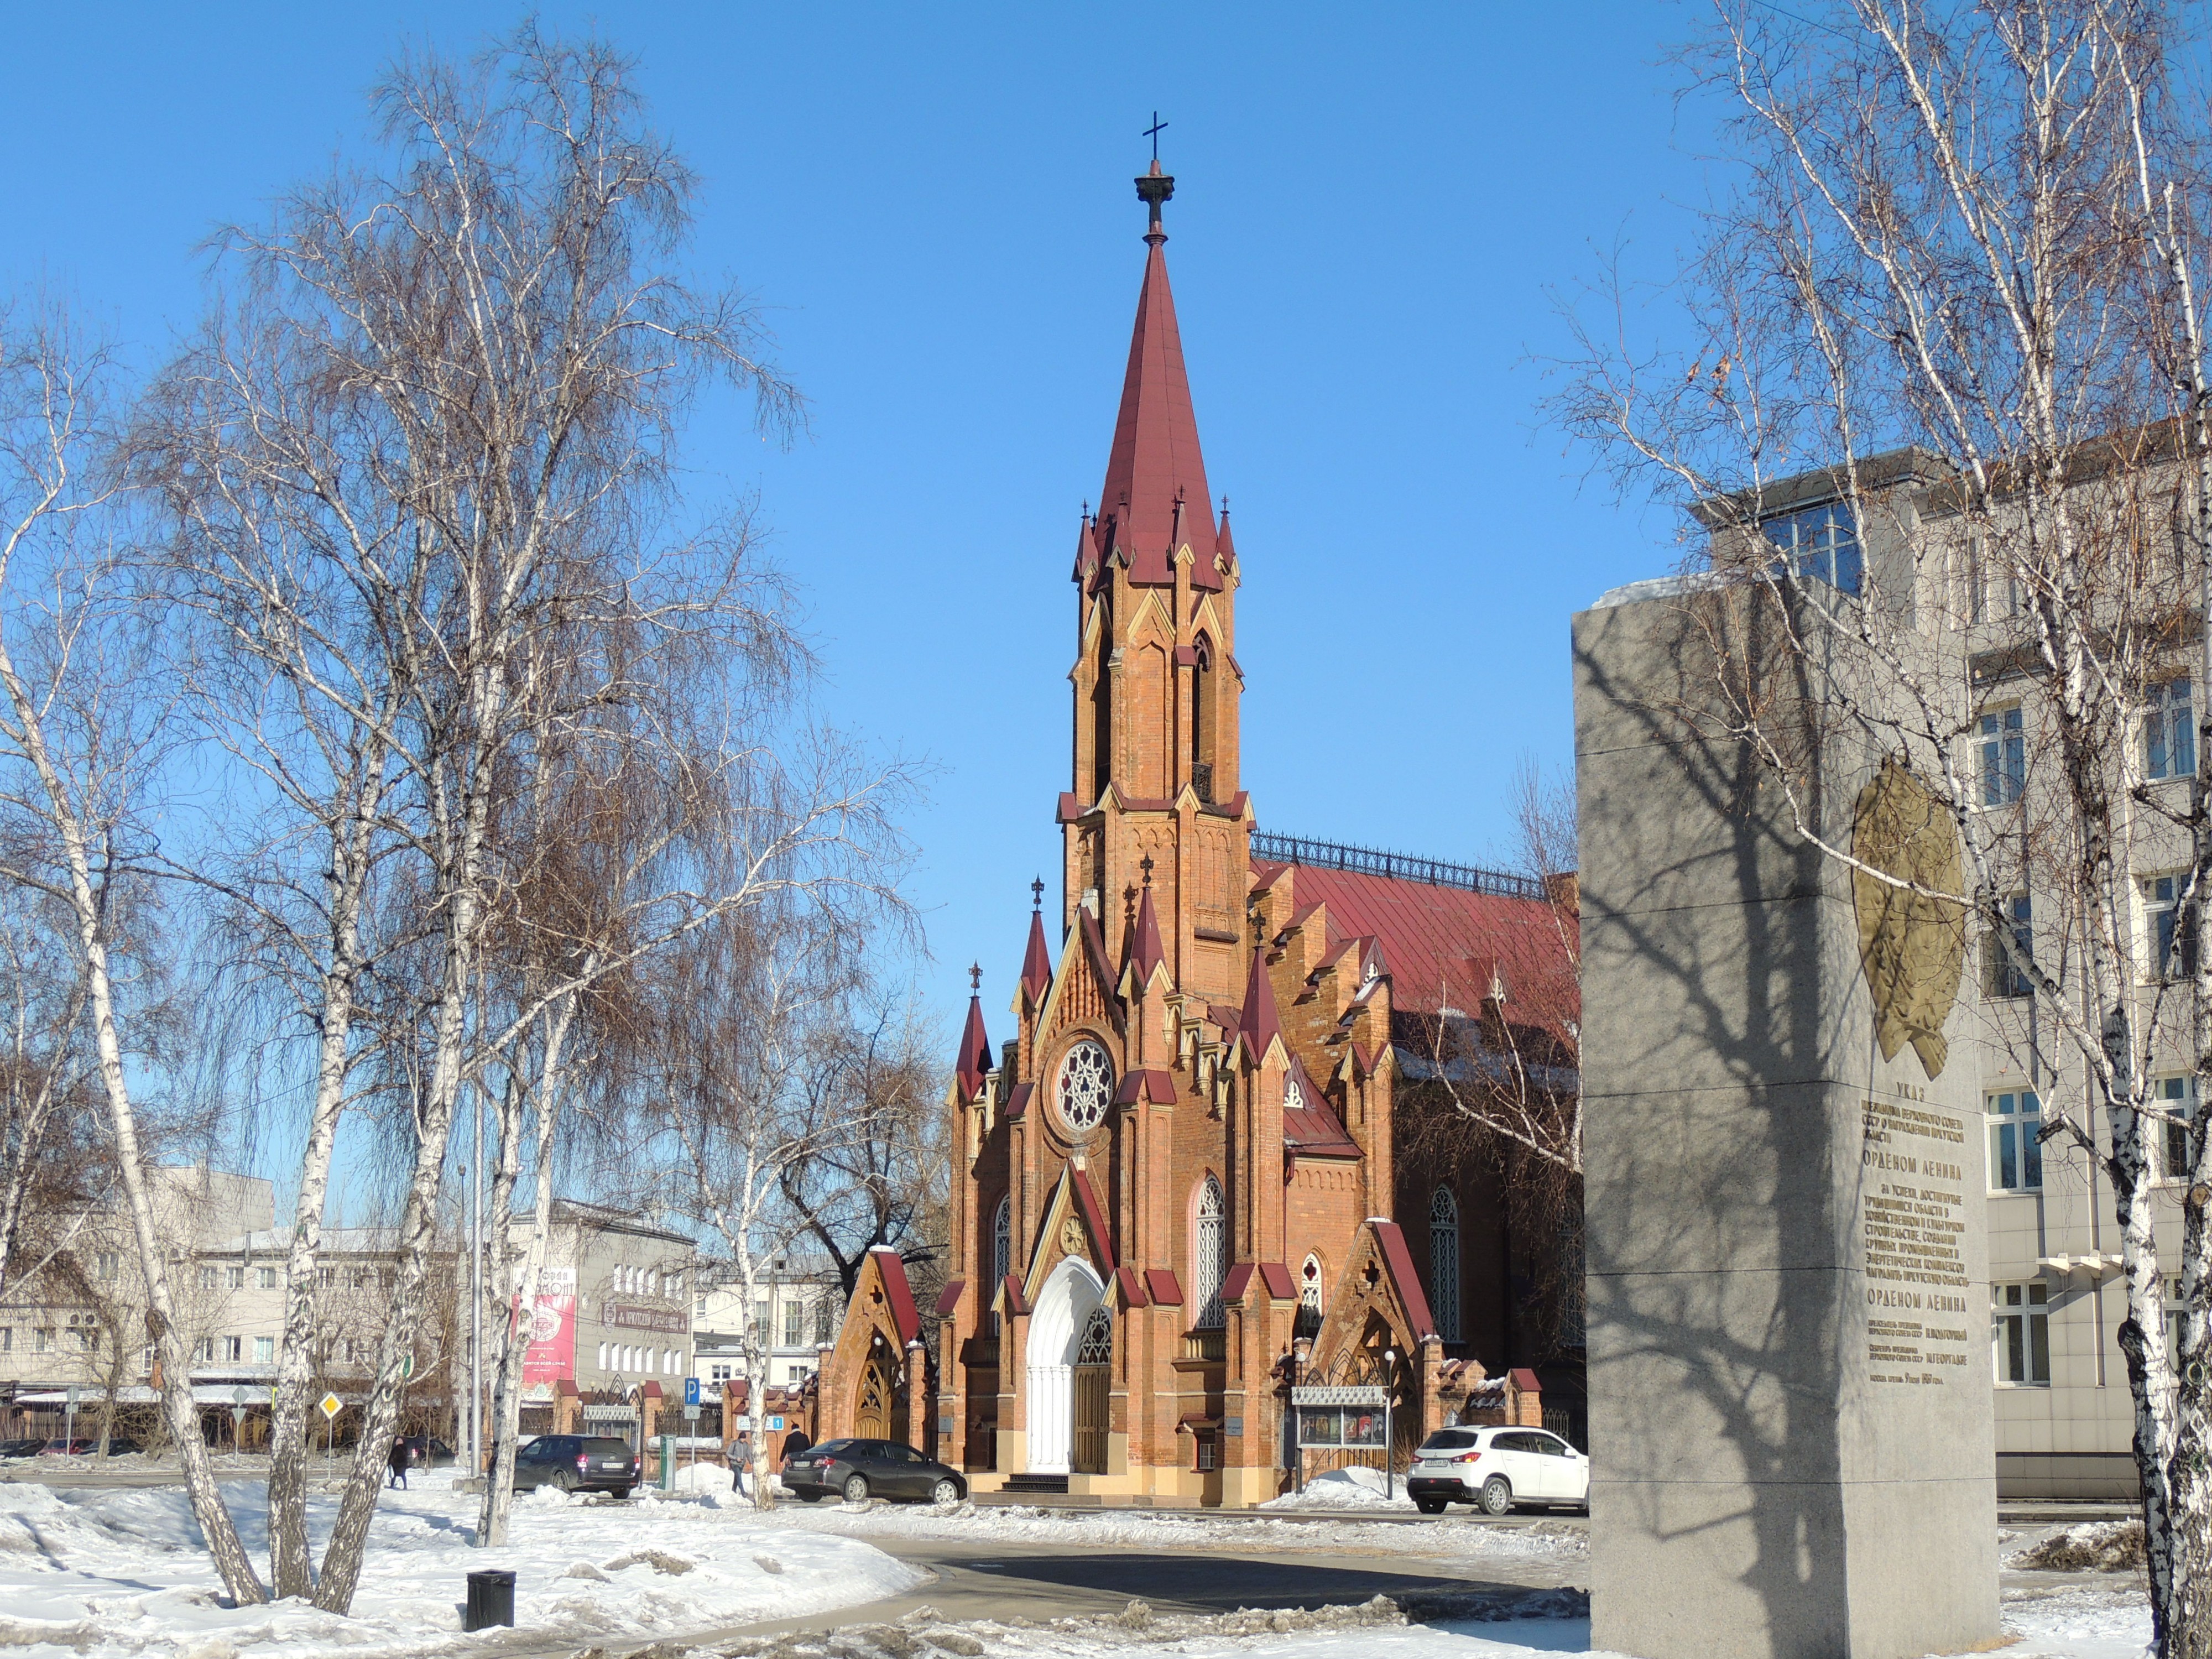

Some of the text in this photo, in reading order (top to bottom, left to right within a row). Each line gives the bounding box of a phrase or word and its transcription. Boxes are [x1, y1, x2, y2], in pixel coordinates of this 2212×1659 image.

[1896, 1082, 1924, 1102] УКАЗ
[1861, 1099, 1963, 1130] ПРЕЗИДИУМА ВЕРХОВНОГО СОВЕТА
[1862, 1114, 1964, 1143] СССР О НАГРАЖДЕНИИ ИРКУТСКОЙ
[1862, 1129, 1891, 1144] ОБЛАСТИ
[1863, 1149, 1961, 1181] ОРДЕНОМ ЛЕНИНА
[1864, 1194, 1949, 1218] ТРУДЯЩИМИСЯ ОБЛАСТИ В
[1881, 1183, 1963, 1206] ЗА УСПЕХИ, ДОСТИГНУТЫЕ
[1865, 1209, 1965, 1233] ХОЗЯЙСТВЕННОМ И КУЛЬТУРНОМ
[1865, 1223, 1921, 1243] СТРОИТЕЛЬСТВЕ,
[1865, 1238, 1959, 1259] КРУПНЫХ ПРОМЫШЛЕННЫХ И
[1866, 1251, 1964, 1274] ЭНЕРГЕТИЧЕСКИХ КОМПЛЕКСОВ
[1866, 1266, 1969, 1287] НАГРАДИТЬ ИРКУТСКУЮ ОБЛАСТЬ
[1867, 1287, 1966, 1313] ОРДЕНОМ ЛЕНИНА
[626, 1310, 651, 1326] ИРКУТСКИЙ
[776, 1419, 780, 1427] 1
